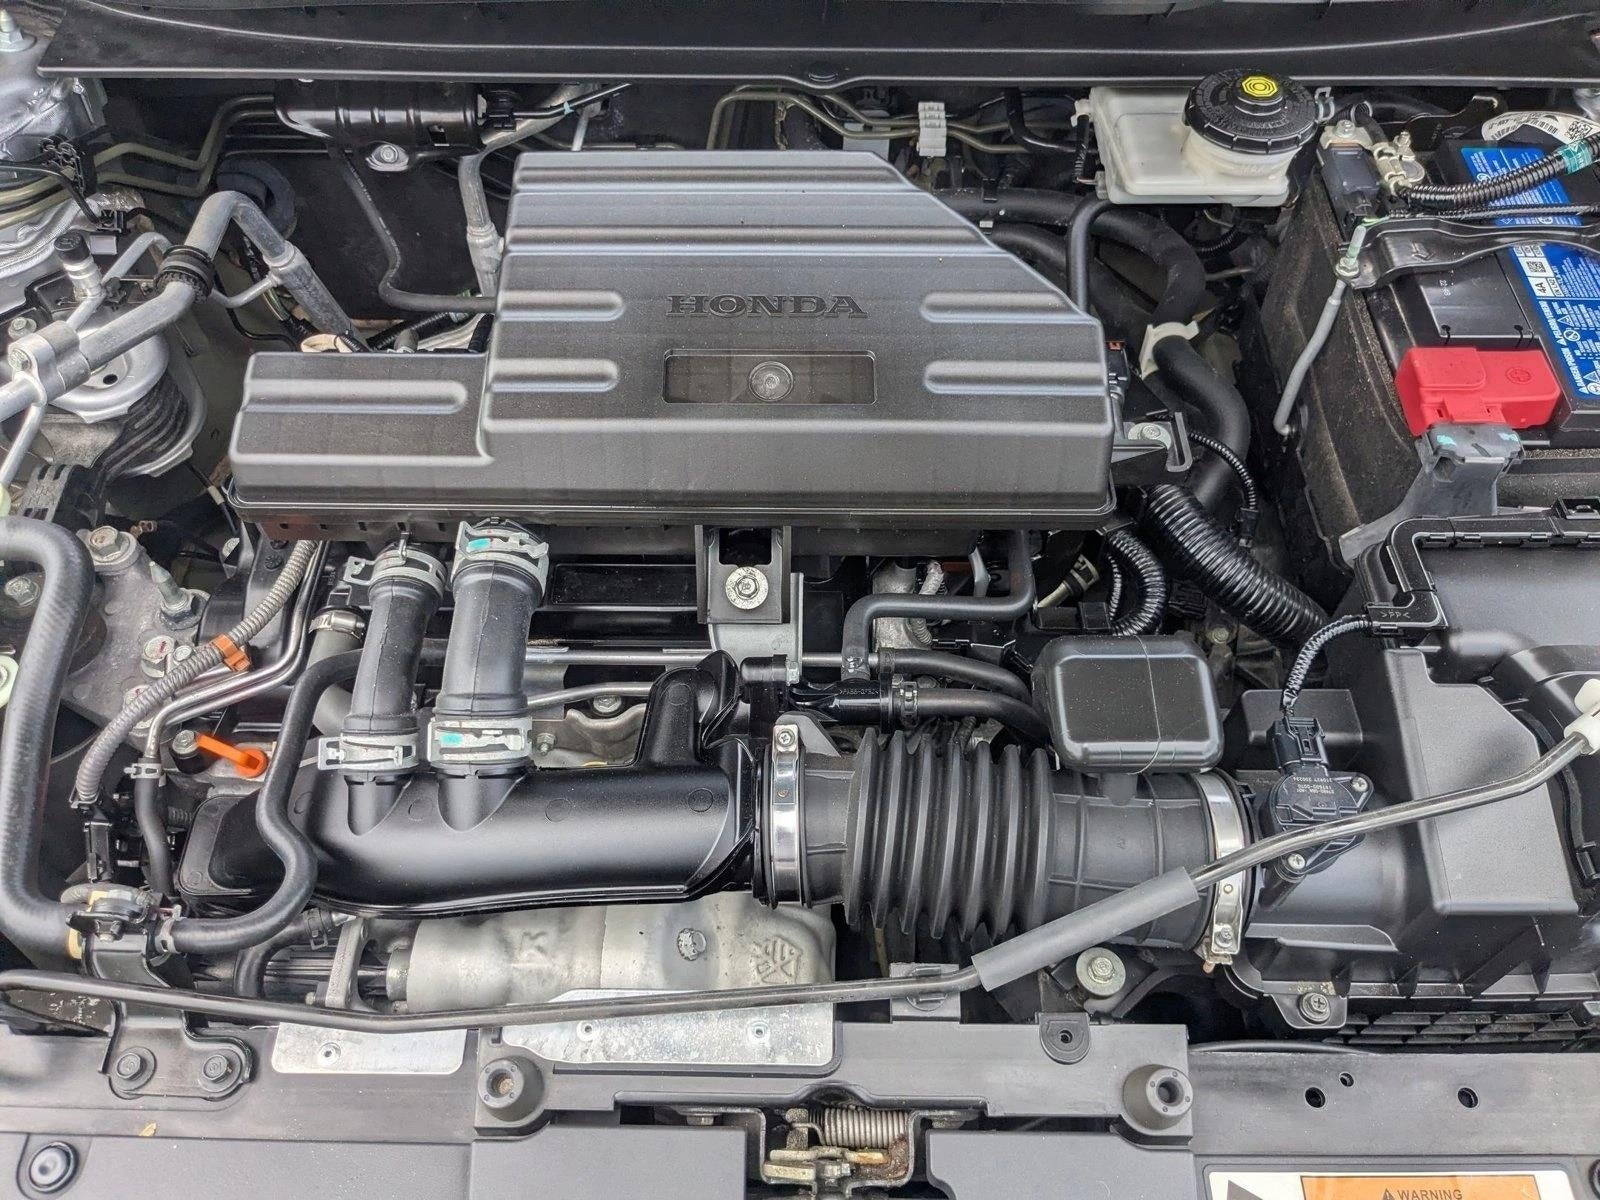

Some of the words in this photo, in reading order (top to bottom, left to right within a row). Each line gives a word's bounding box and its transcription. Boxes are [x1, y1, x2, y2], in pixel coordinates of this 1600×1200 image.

[1535, 282, 1547, 294] 4A
[665, 294, 868, 319] HONDA
[1397, 1189, 1463, 1200] WARNING
